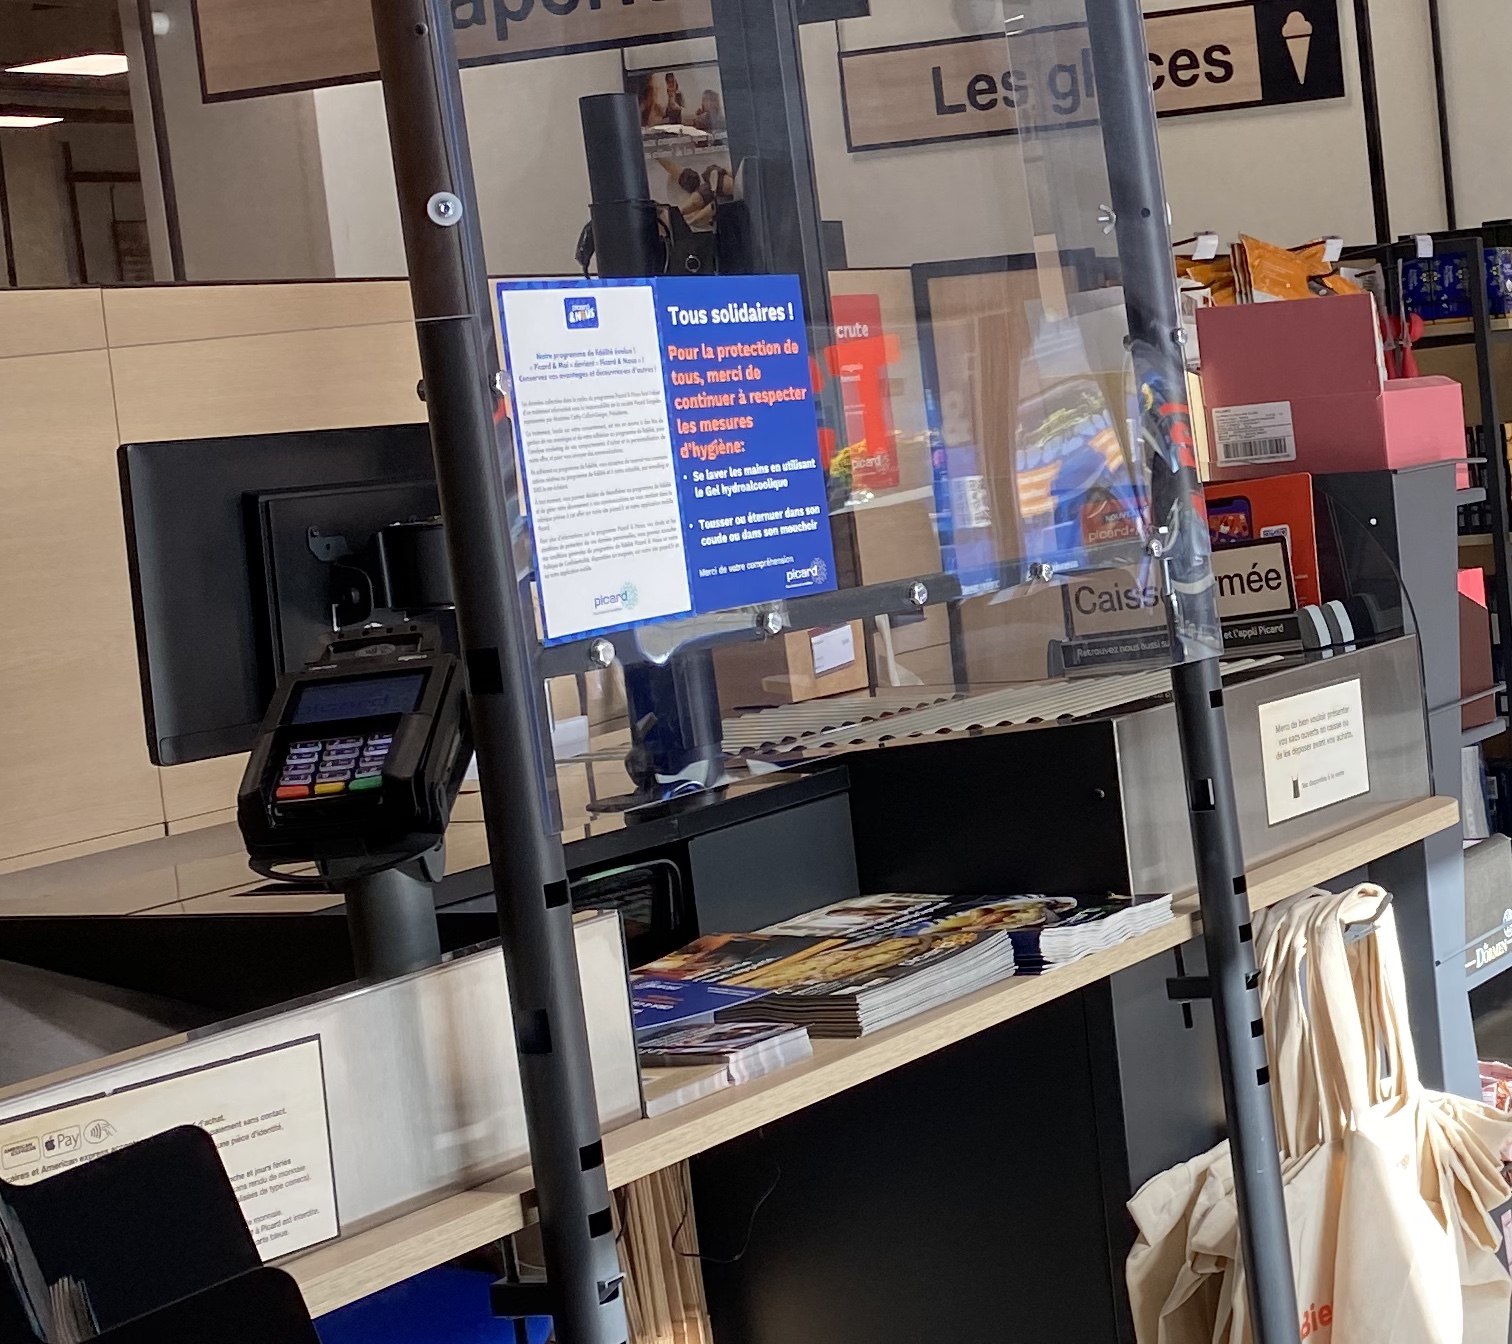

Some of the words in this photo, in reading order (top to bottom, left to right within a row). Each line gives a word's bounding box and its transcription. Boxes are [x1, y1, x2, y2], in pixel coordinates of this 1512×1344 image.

[932, 66, 1028, 115] Les
[1049, 44, 1234, 115] glces
[667, 306, 708, 325] Tous
[711, 302, 786, 323] solidaires
[787, 302, 795, 321] !
[668, 345, 699, 361] Pour
[701, 343, 715, 359] la
[717, 340, 781, 362] protection
[784, 339, 799, 354] de
[671, 370, 705, 386] tous,
[707, 365, 742, 383] merci
[745, 365, 761, 380] de
[674, 391, 736, 410] continuer
[738, 388, 747, 404] à
[749, 387, 808, 406] respecter
[677, 419, 697, 434] les
[700, 416, 754, 432] mesures
[680, 439, 746, 461] d'hygiène:
[693, 470, 704, 482] Se
[706, 468, 728, 480] laver
[729, 466, 742, 478] les
[743, 463, 769, 476] mains
[770, 463, 781, 473] en
[782, 458, 816, 471] utilisant
[694, 486, 704, 498] le
[705, 484, 721, 497] Gel
[722, 478, 788, 497] hydroalcoolique
[698, 516, 733, 531] Tousser
[735, 515, 746, 526] ou
[747, 509, 783, 523] éternuer
[784, 507, 804, 519] dans
[805, 505, 821, 516] son
[700, 532, 728, 547] coude
[729, 532, 740, 542] ou
[741, 528, 762, 541] dans
[763, 526, 779, 537] son
[780, 519, 818, 534] mouchoir
[786, 564, 818, 582] picard
[594, 591, 628, 609] picard
[1259, 623, 1284, 636] Picard
[57, 1133, 79, 1149] Pay
[41, 1158, 79, 1174] American
[261, 1219, 282, 1233] Picard
